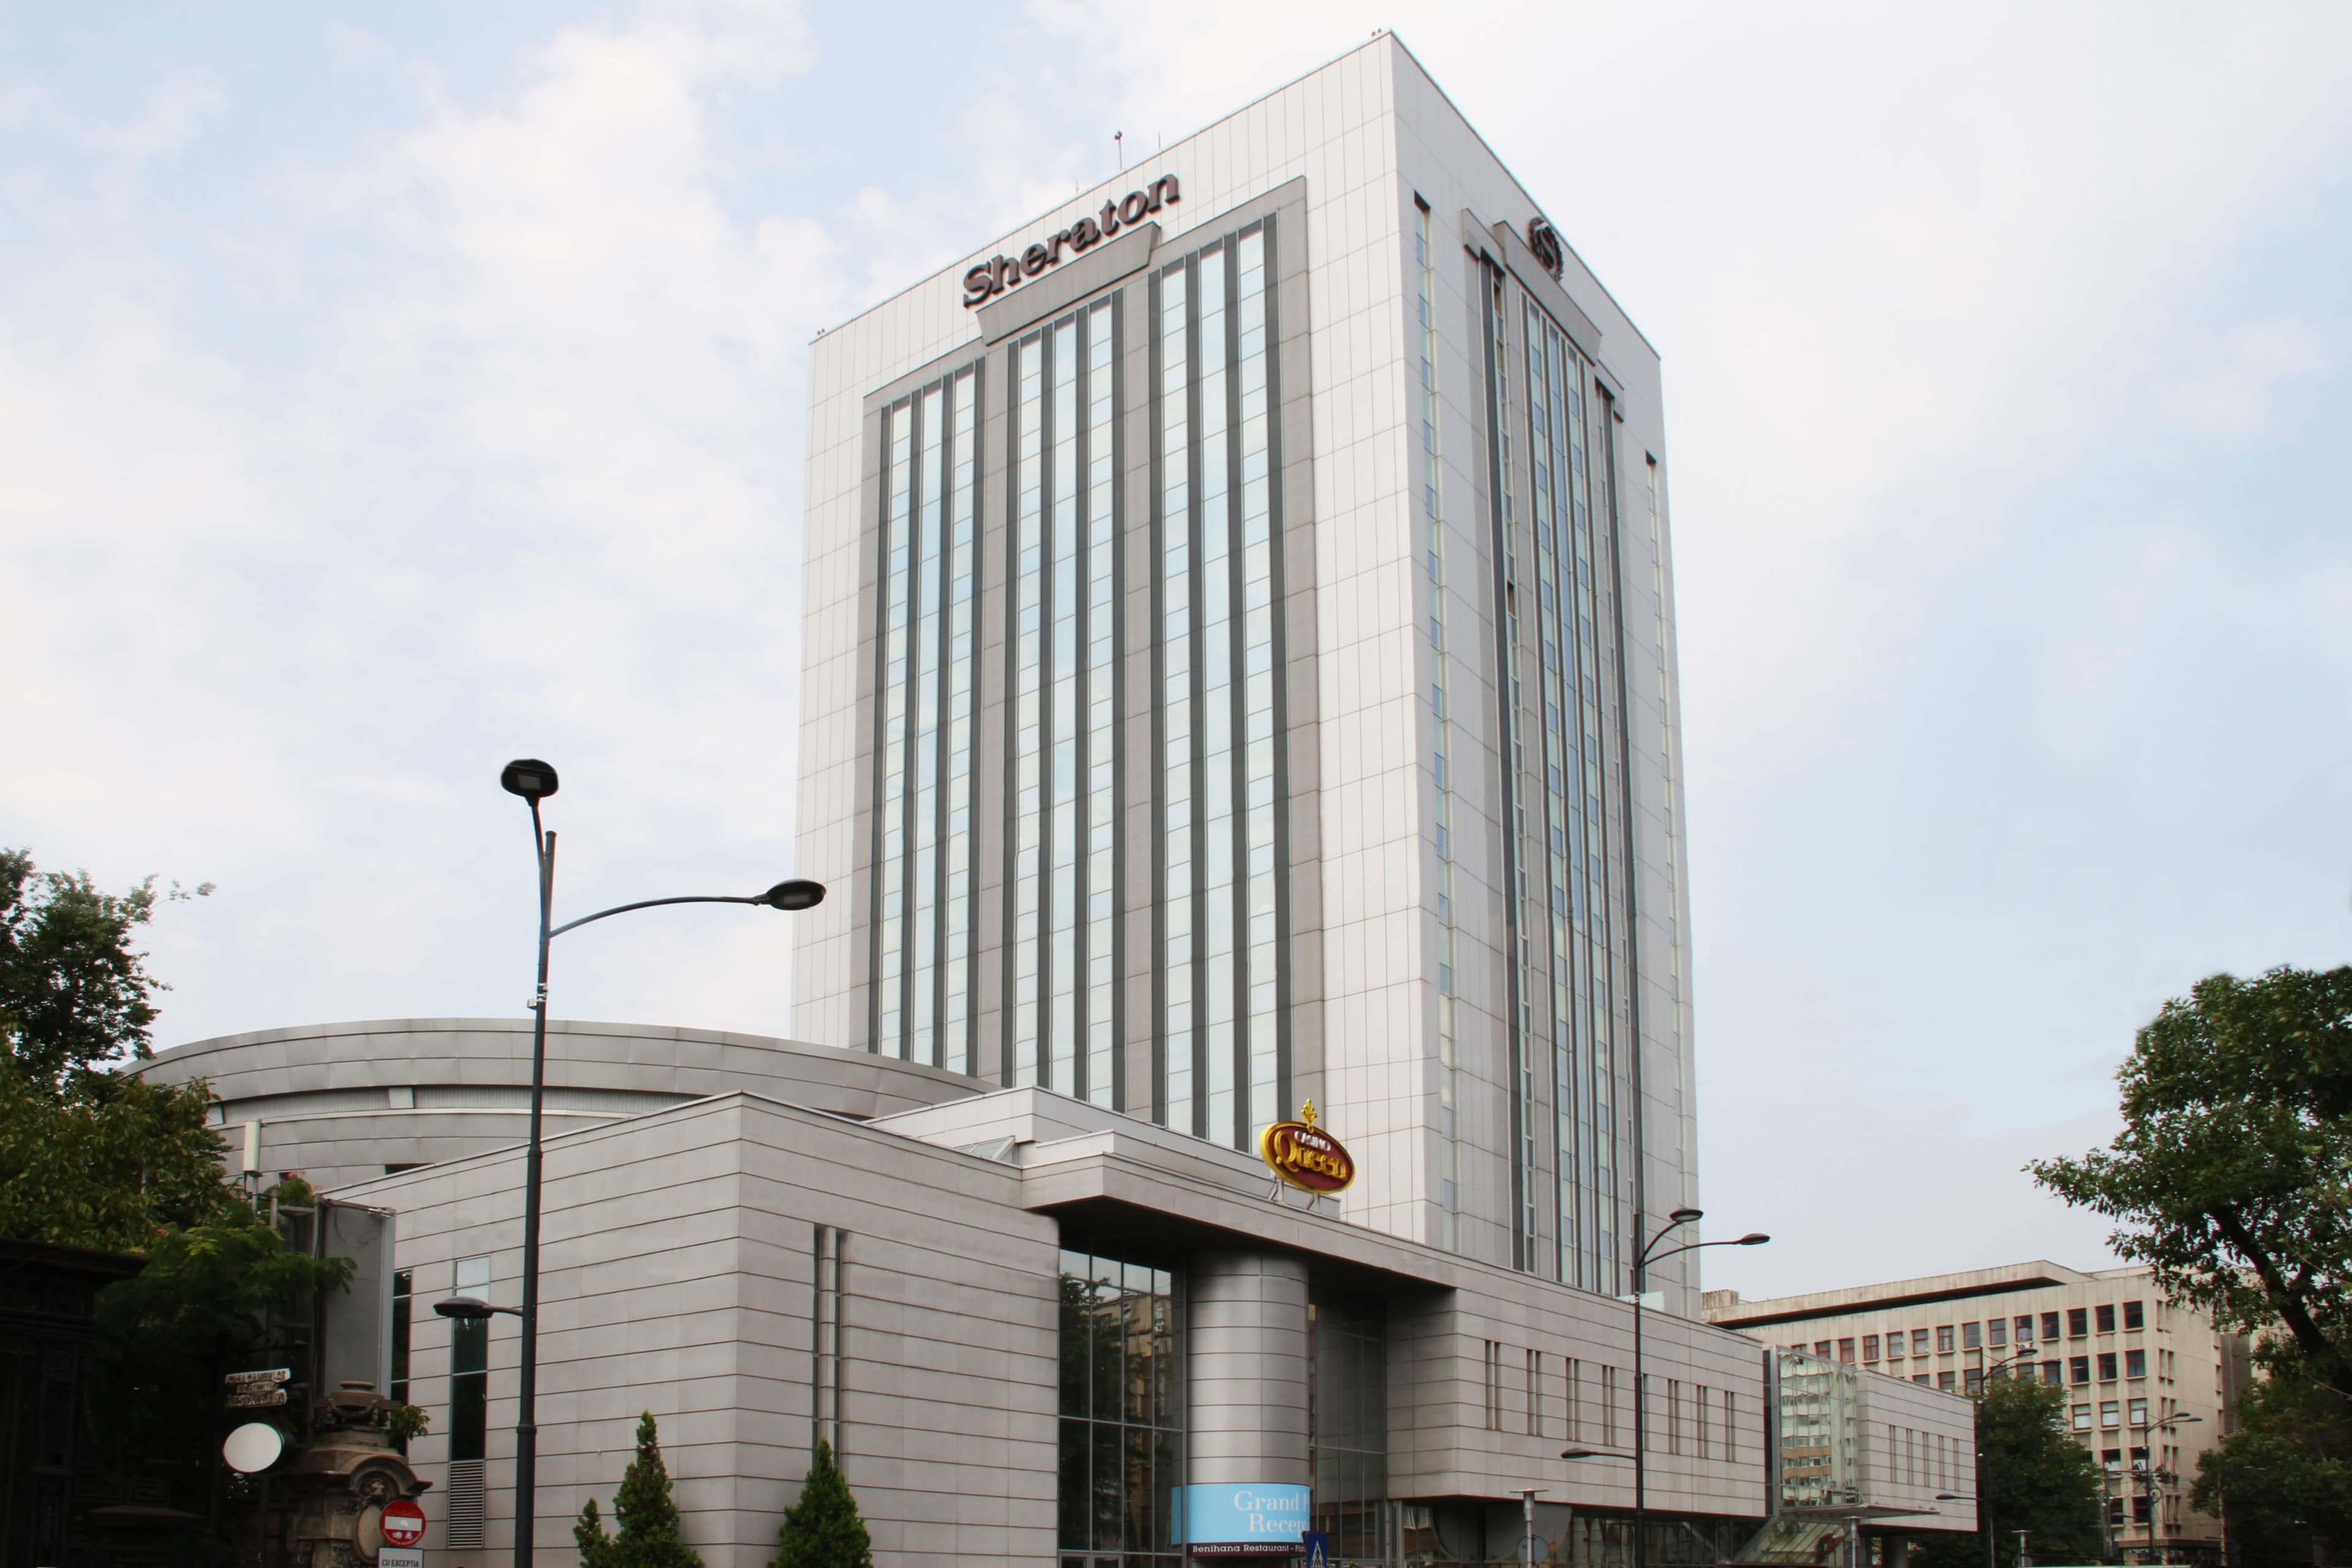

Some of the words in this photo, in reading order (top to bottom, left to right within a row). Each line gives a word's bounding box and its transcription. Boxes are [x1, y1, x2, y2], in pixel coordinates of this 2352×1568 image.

[963, 173, 1180, 307] Sheraton
[1273, 1130, 1346, 1178] Queen
[1234, 1490, 1299, 1512] Grand
